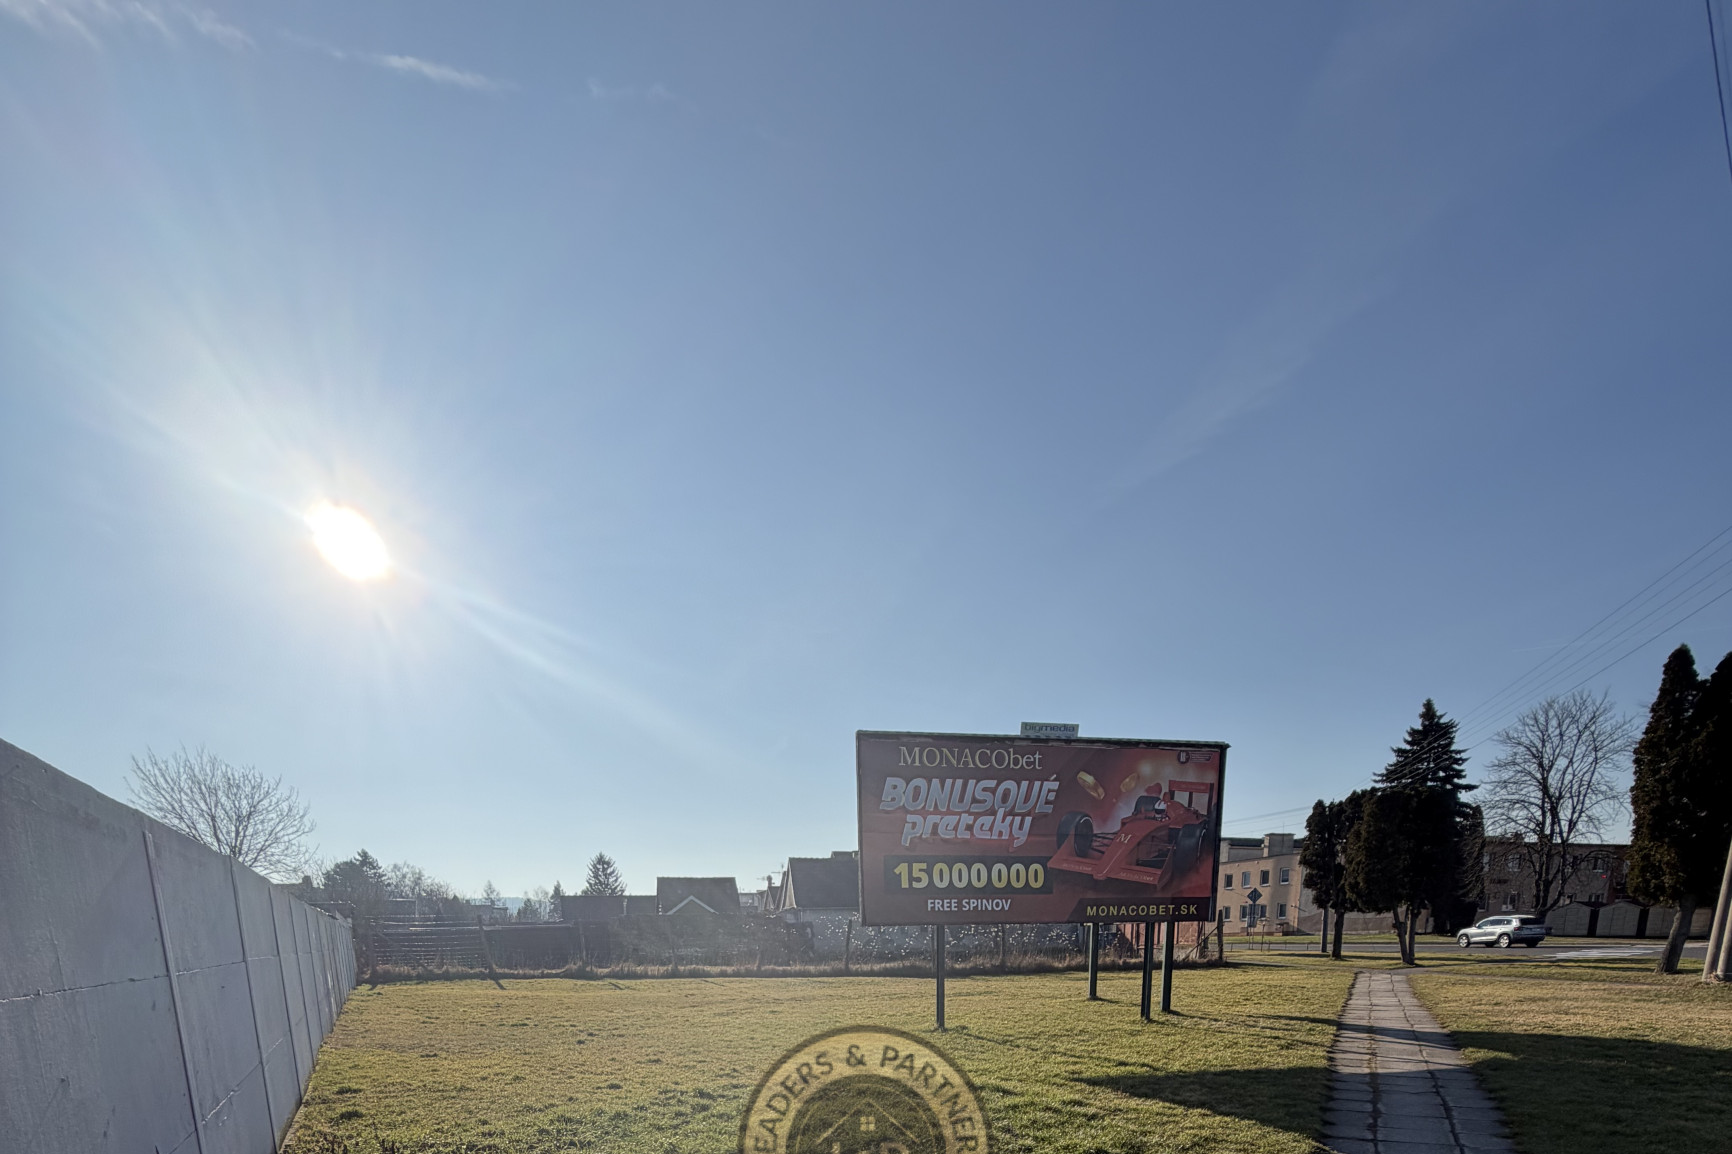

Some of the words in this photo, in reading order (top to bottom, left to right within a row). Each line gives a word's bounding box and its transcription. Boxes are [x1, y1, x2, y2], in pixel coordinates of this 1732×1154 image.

[1024, 723, 1075, 733] bigmedia
[898, 746, 1042, 770] MONACObet
[879, 774, 1060, 813] BONUSOVÉ
[901, 807, 1032, 847] preteky
[1117, 833, 1132, 844] M
[927, 899, 958, 911] FREE
[962, 899, 1011, 911] SPINOV
[1086, 904, 1198, 916] MONACOBET.SK
